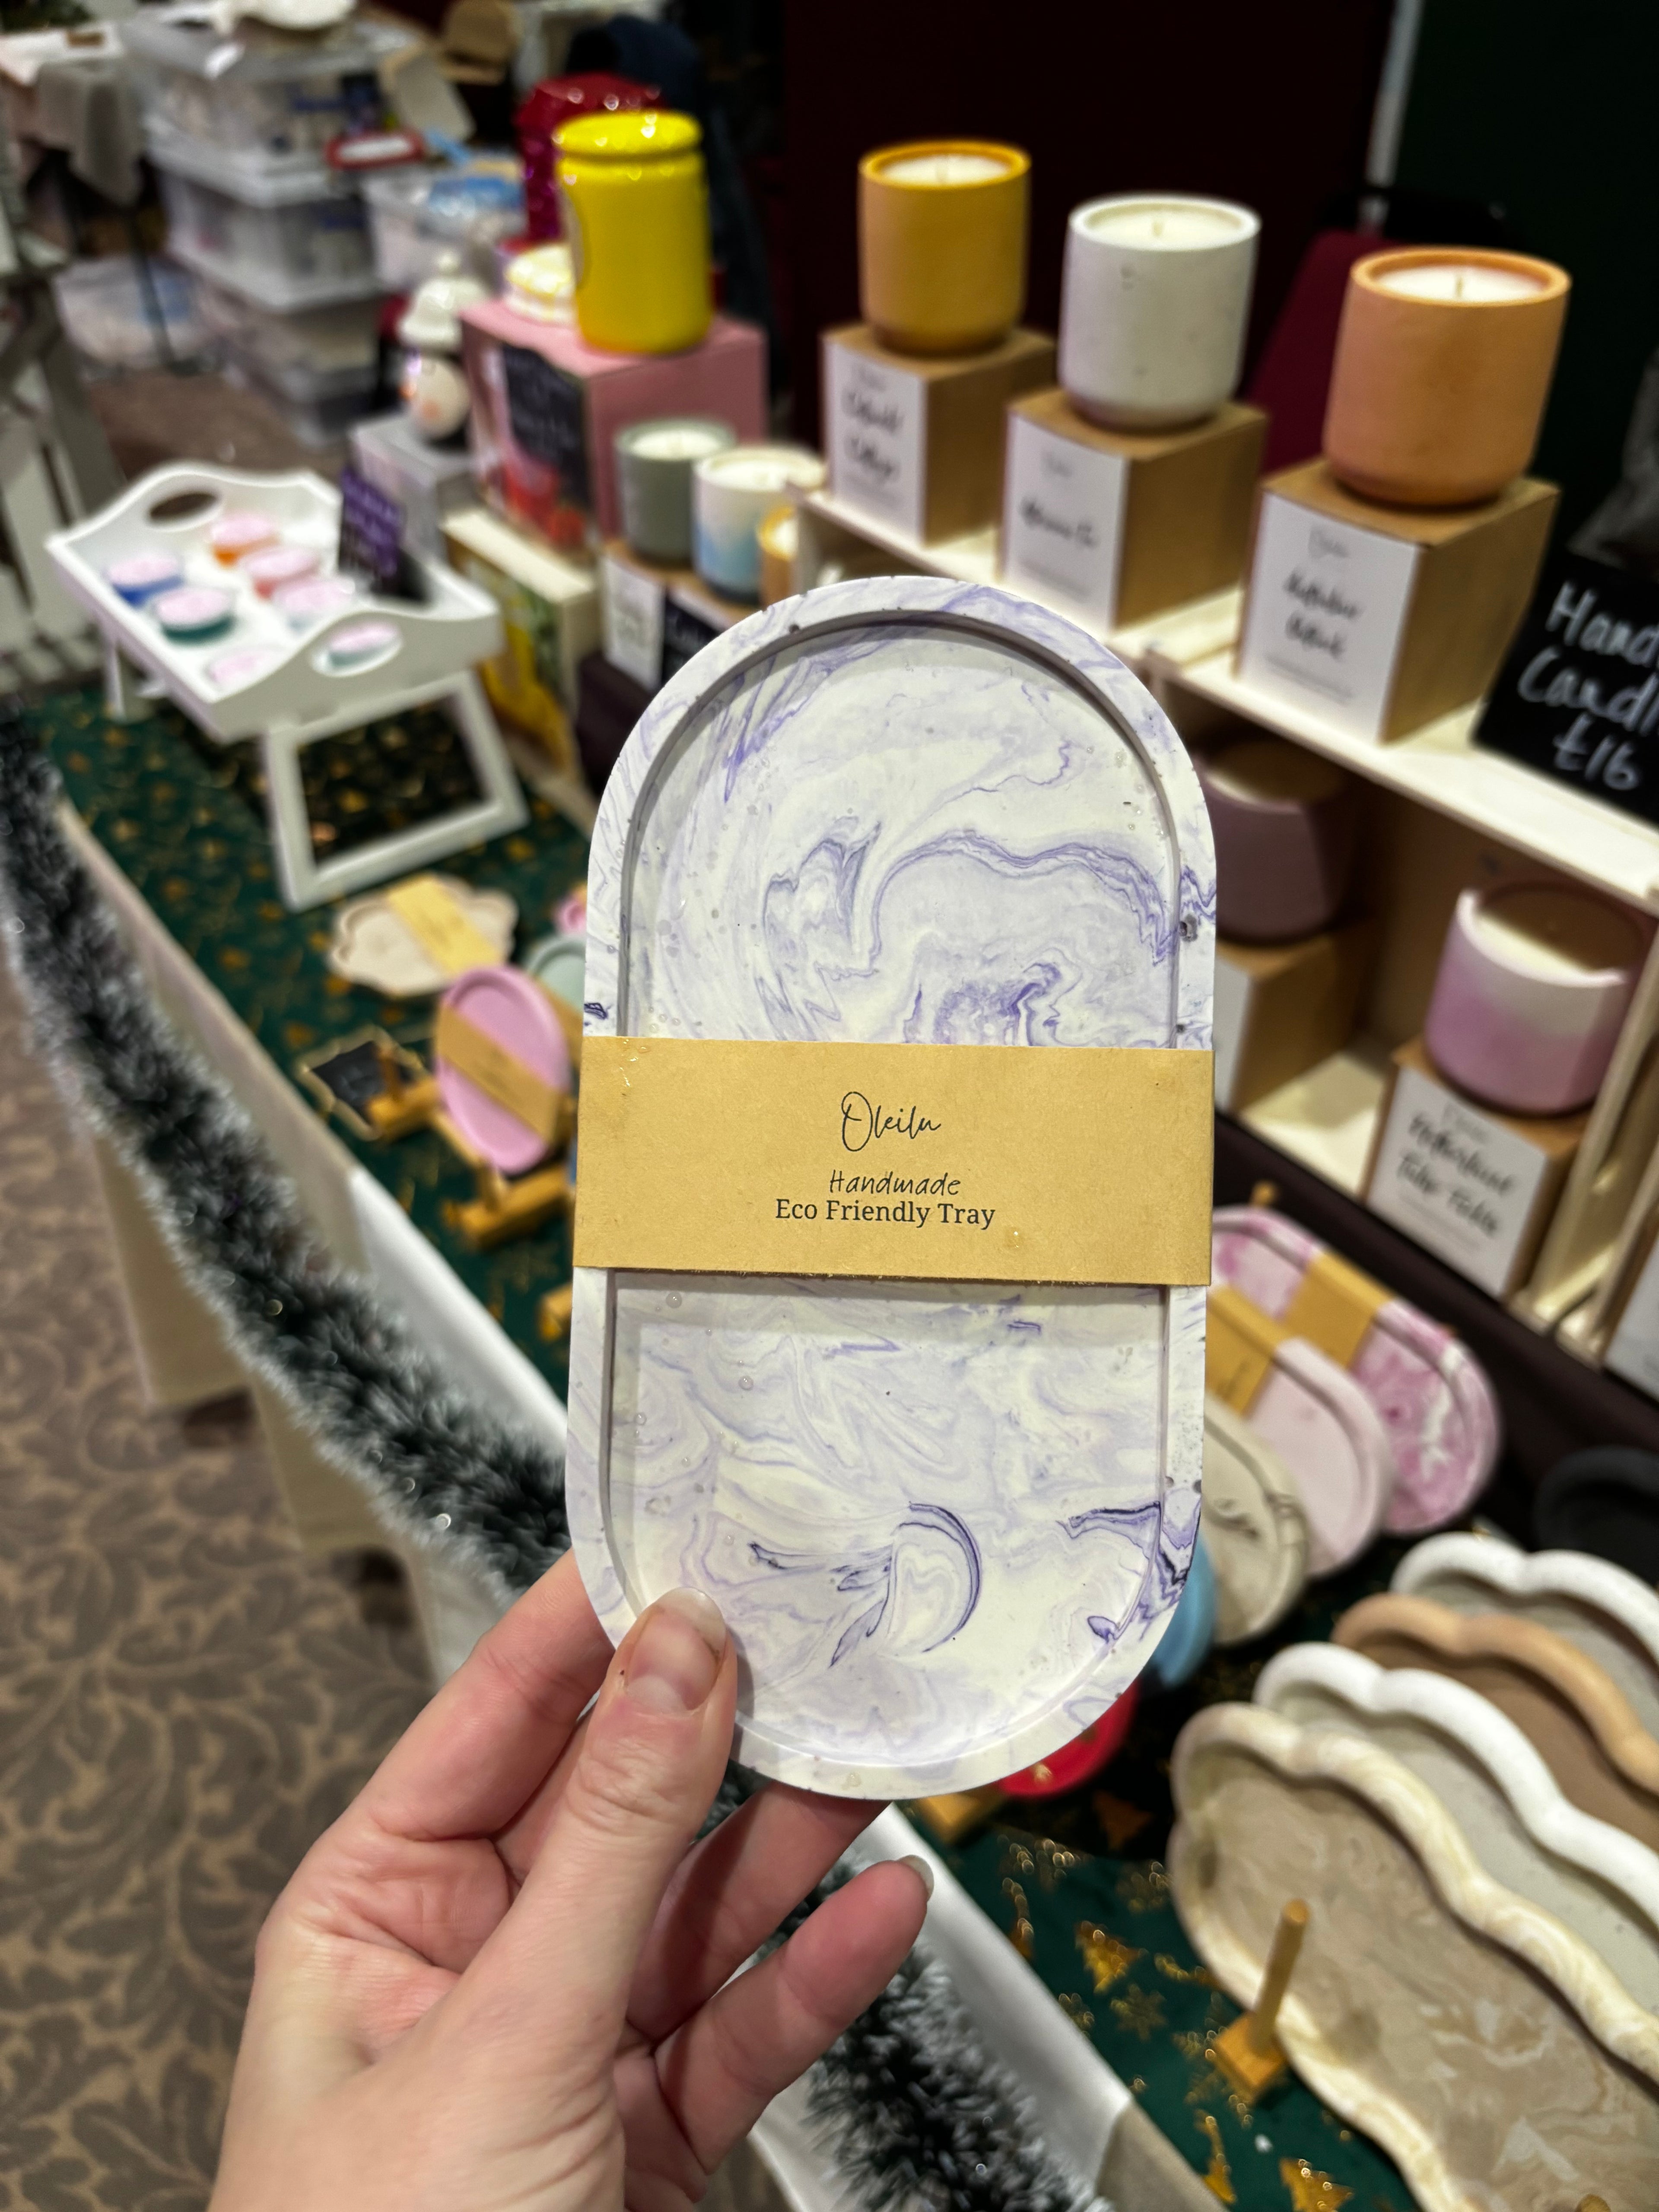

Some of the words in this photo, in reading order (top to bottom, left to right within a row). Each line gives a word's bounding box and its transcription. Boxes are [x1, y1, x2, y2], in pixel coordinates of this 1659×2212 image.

[1554, 713, 1639, 790] £16
[829, 1169, 961, 1196] Handmade
[775, 1198, 818, 1220] Eco
[825, 1199, 931, 1229] Friendly
[937, 1203, 996, 1230] Tray
